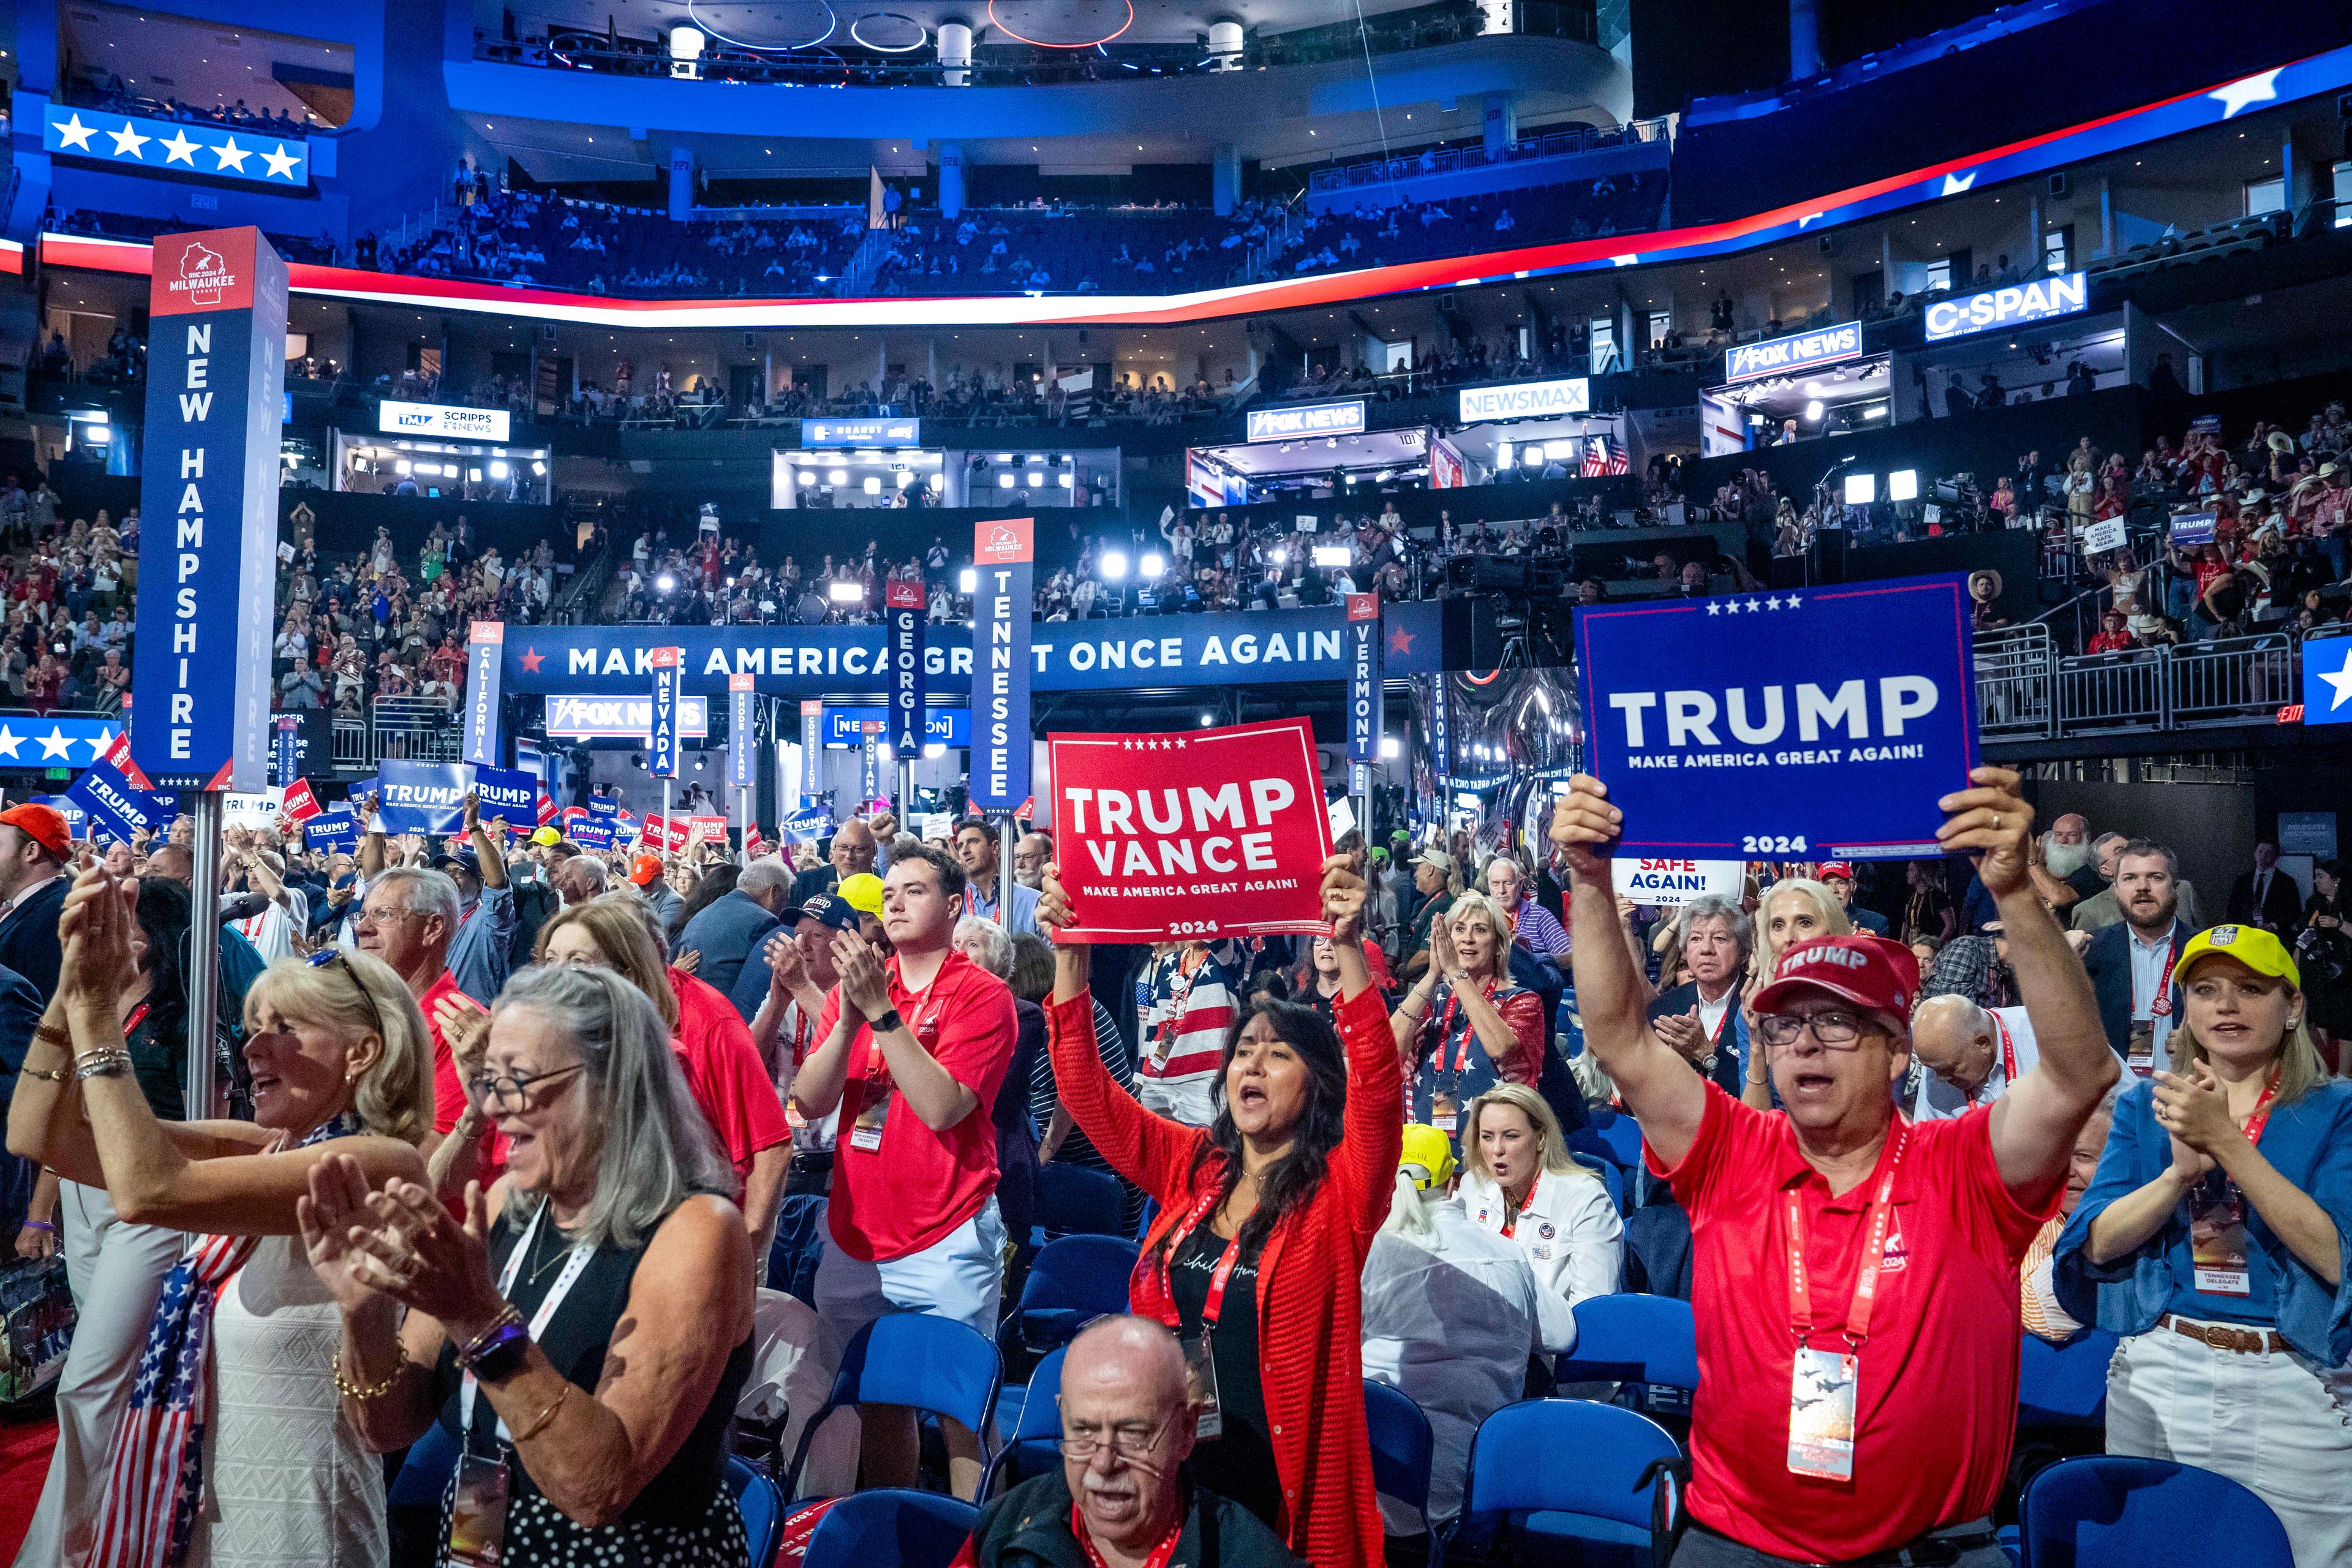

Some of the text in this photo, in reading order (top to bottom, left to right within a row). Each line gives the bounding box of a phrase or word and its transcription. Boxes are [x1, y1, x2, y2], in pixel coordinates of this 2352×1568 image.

[674, 160, 689, 170] 227
[170, 276, 235, 292] MILWAUKEE
[1926, 273, 2084, 334] C-SPAN
[1928, 331, 1954, 341] POWERED
[1750, 328, 1856, 364] FOX NEWS
[1467, 386, 1583, 413] NEWSMAX
[445, 412, 491, 423] SCRIPPS
[1266, 406, 1360, 430] FOX NEWS
[459, 424, 491, 432] NEWS
[1399, 435, 1417, 445] 101
[2090, 528, 2117, 538] AMERICA
[2095, 524, 2111, 532] MAKE
[2174, 519, 2212, 530] TRUMP
[170, 324, 214, 760] NEW HAMPSHIRE
[2095, 538, 2116, 548] AGAIN!
[2096, 533, 2113, 542] SAFE
[568, 647, 685, 675] MAK
[703, 646, 888, 675] AMERICA
[924, 642, 1053, 674] GRT
[1069, 636, 1184, 671] ONCE
[899, 612, 916, 748] GEORGIA
[990, 571, 1012, 796] TENNESSEE
[1354, 625, 1370, 754] VERMONT
[473, 647, 492, 758] CALIFORNIA
[1609, 676, 1939, 747] TRUMP
[573, 703, 627, 726] FOX
[656, 671, 671, 769] NEVADA
[2280, 705, 2303, 723] EXIT
[865, 735, 875, 796] MONTANA
[1628, 744, 1925, 769] MAKE AMERICA GREAT AGAIN!
[87, 774, 148, 826] TRUMP
[284, 791, 310, 812] TRUMP
[383, 784, 462, 804] TRUMP
[473, 782, 532, 803] TRUMP
[590, 801, 616, 812] TRUMP
[1065, 777, 1296, 836] TRUMP
[92, 813, 107, 826] 2024
[307, 821, 350, 834] TRUMP
[786, 816, 827, 831] TRUMP
[571, 824, 611, 836] TRUMP
[574, 833, 605, 842] VANCE
[1085, 831, 1278, 877] VANCE
[1743, 835, 1808, 854] 2024
[1640, 858, 1696, 872] SAFE
[1083, 878, 1298, 897] MAKE AMERICA GREAT AGAIN!
[1629, 873, 1706, 891] AGAIN!
[1169, 920, 1219, 935] 2024
[1781, 946, 1868, 976] TRUMP
[1881, 1256, 1905, 1267] 024
